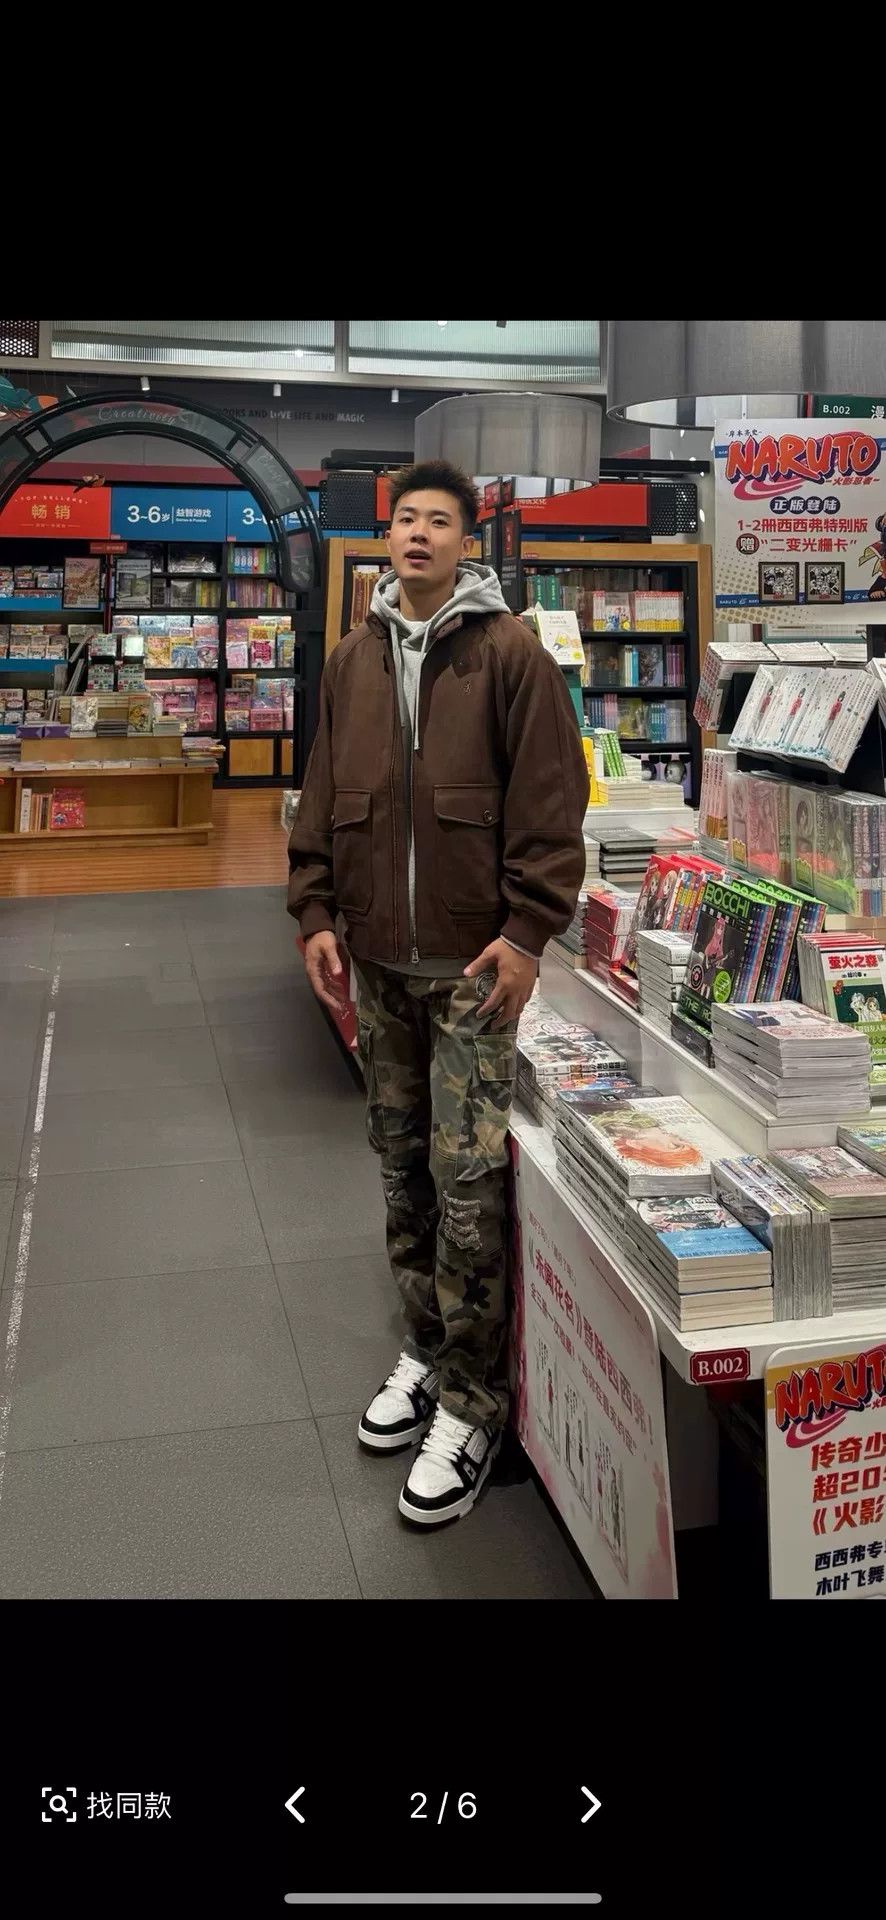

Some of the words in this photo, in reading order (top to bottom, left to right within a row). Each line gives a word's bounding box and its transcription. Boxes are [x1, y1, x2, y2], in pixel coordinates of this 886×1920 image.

[336, 413, 366, 423] MAGIC
[823, 405, 850, 415] B.002
[725, 434, 881, 484] NARUTO
[31, 504, 71, 520] 畅销
[772, 498, 838, 512] 正版登陆
[737, 518, 868, 533] 1-2册西西弗特别版
[740, 537, 755, 552] 赠
[705, 884, 750, 919] BOCCHI
[828, 954, 879, 970] 萤火之森
[698, 1357, 744, 1376] B.002
[775, 1349, 886, 1432] NARUT
[812, 1466, 886, 1503] 超20
[813, 1494, 885, 1535] 《火影
[815, 1540, 886, 1571] 西西弗专
[816, 1565, 885, 1596] 木叶飞舞
